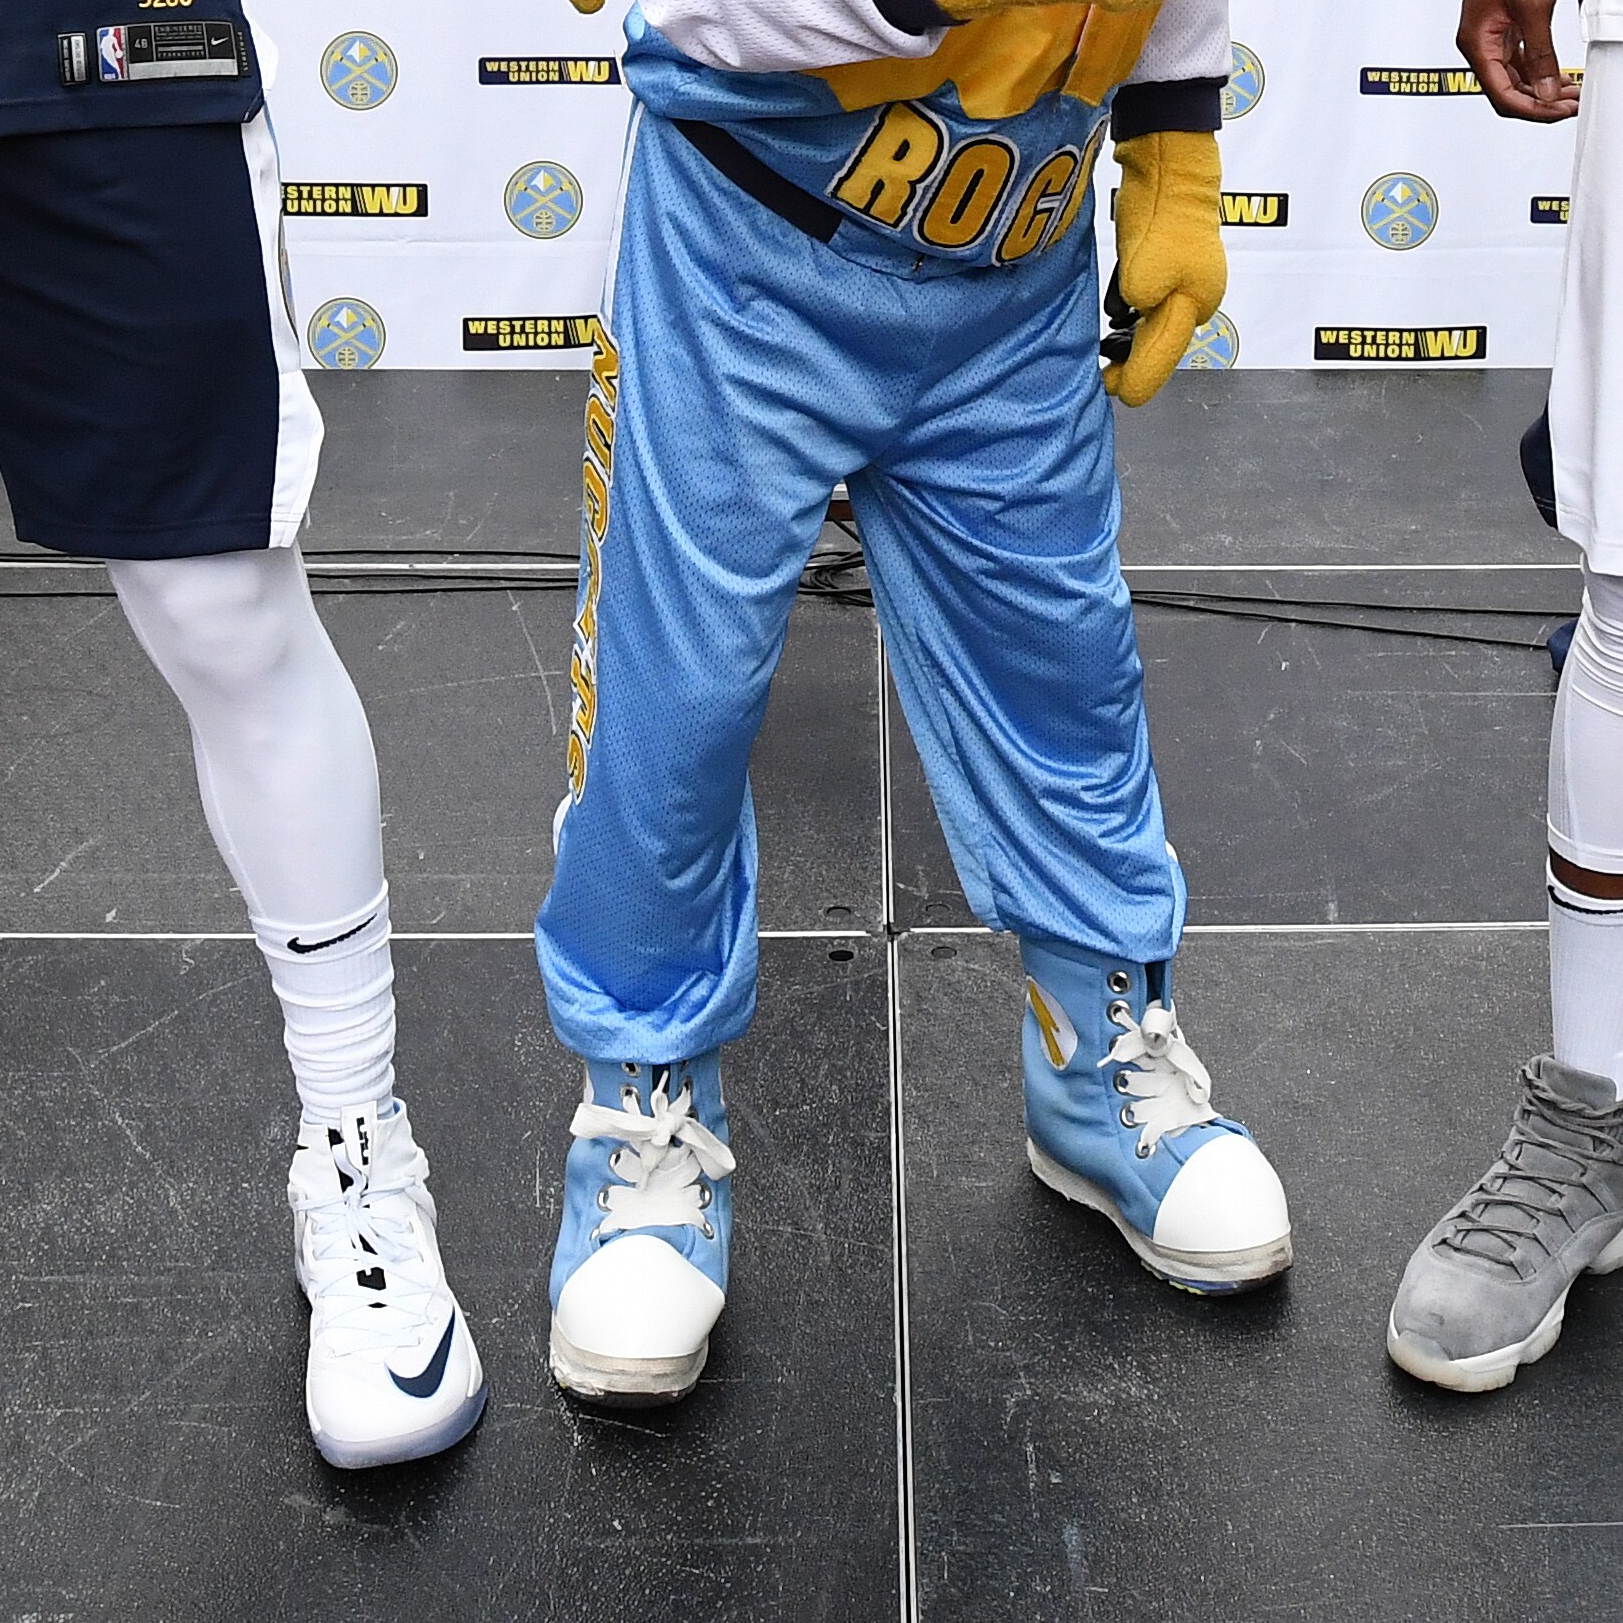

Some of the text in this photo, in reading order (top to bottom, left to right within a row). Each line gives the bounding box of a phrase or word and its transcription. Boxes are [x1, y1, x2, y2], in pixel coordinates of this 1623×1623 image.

[485, 61, 559, 71] WESTERN
[567, 61, 610, 82] WU
[508, 71, 559, 82] UNION
[1367, 71, 1439, 82] WESTERN
[1389, 82, 1439, 93] UNION
[281, 185, 352, 200] STERN
[286, 199, 352, 213] UNION
[362, 186, 418, 214] WU
[1222, 195, 1279, 224] WU
[468, 320, 564, 334] WESTERN
[498, 333, 564, 347] UNION
[1320, 330, 1416, 344] WESTERN
[1426, 330, 1477, 357] WU
[1349, 344, 1415, 358] UNION
